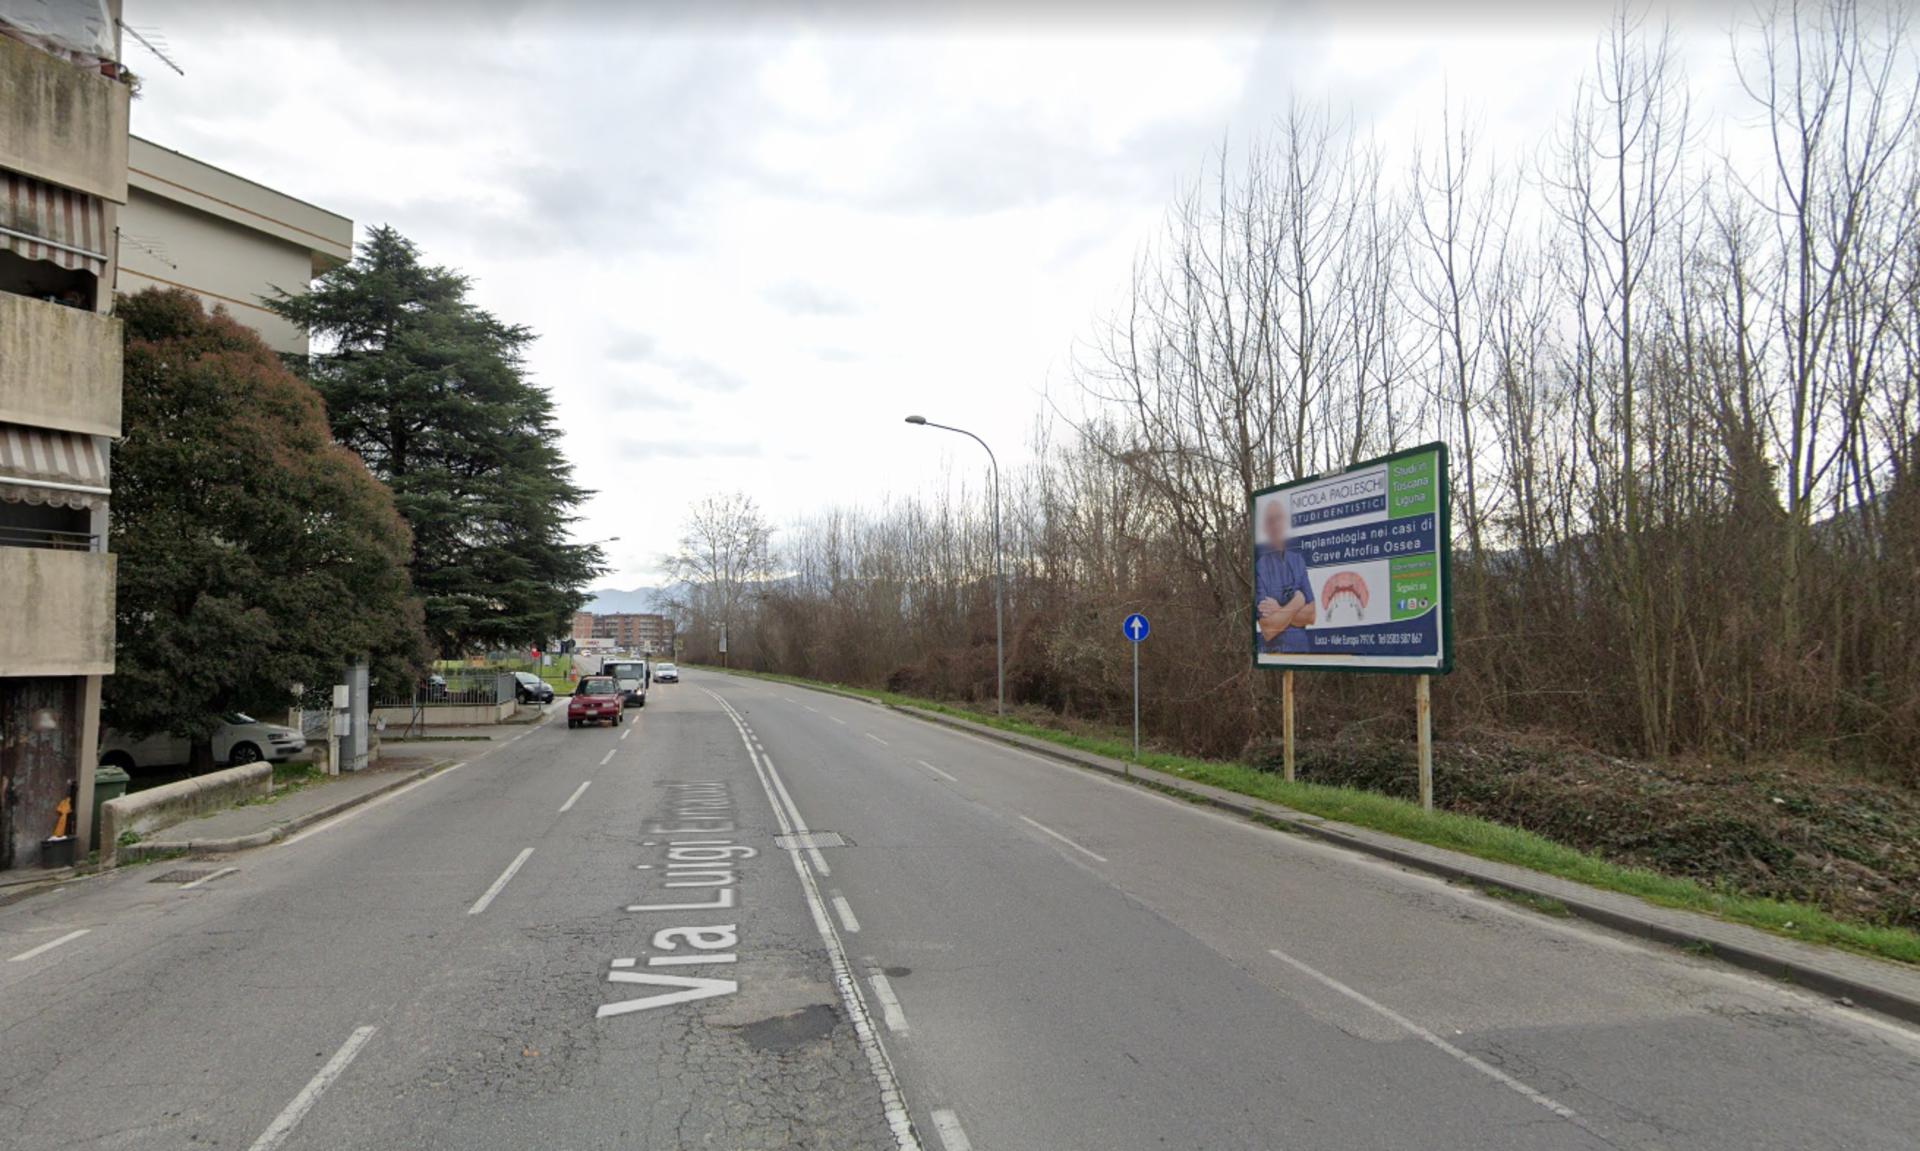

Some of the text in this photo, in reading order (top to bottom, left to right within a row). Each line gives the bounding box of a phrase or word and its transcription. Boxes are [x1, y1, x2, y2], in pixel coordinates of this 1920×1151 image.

[1292, 490, 1327, 508] NICOLA
[1322, 497, 1385, 518] DENTISTICI
[1301, 518, 1433, 551] Implantologia nei casi di
[1312, 539, 1421, 563] Grave Atrofia Ossea
